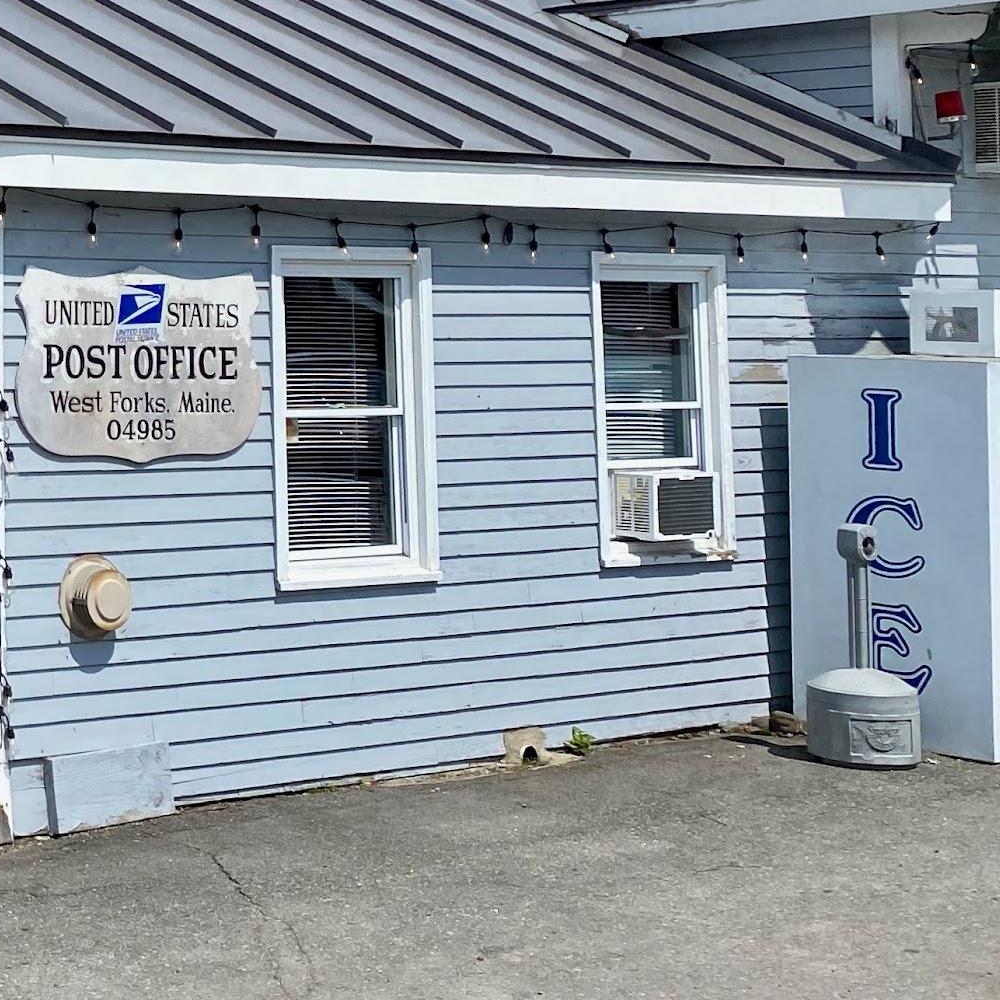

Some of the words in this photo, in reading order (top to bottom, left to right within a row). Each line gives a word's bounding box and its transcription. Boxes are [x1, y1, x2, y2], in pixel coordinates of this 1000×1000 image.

[45, 299, 115, 327] UNITED
[167, 302, 239, 329] STATES
[43, 344, 127, 380] POST
[133, 345, 239, 380] OFFICE
[50, 390, 103, 414] West
[106, 419, 176, 441] 04985
